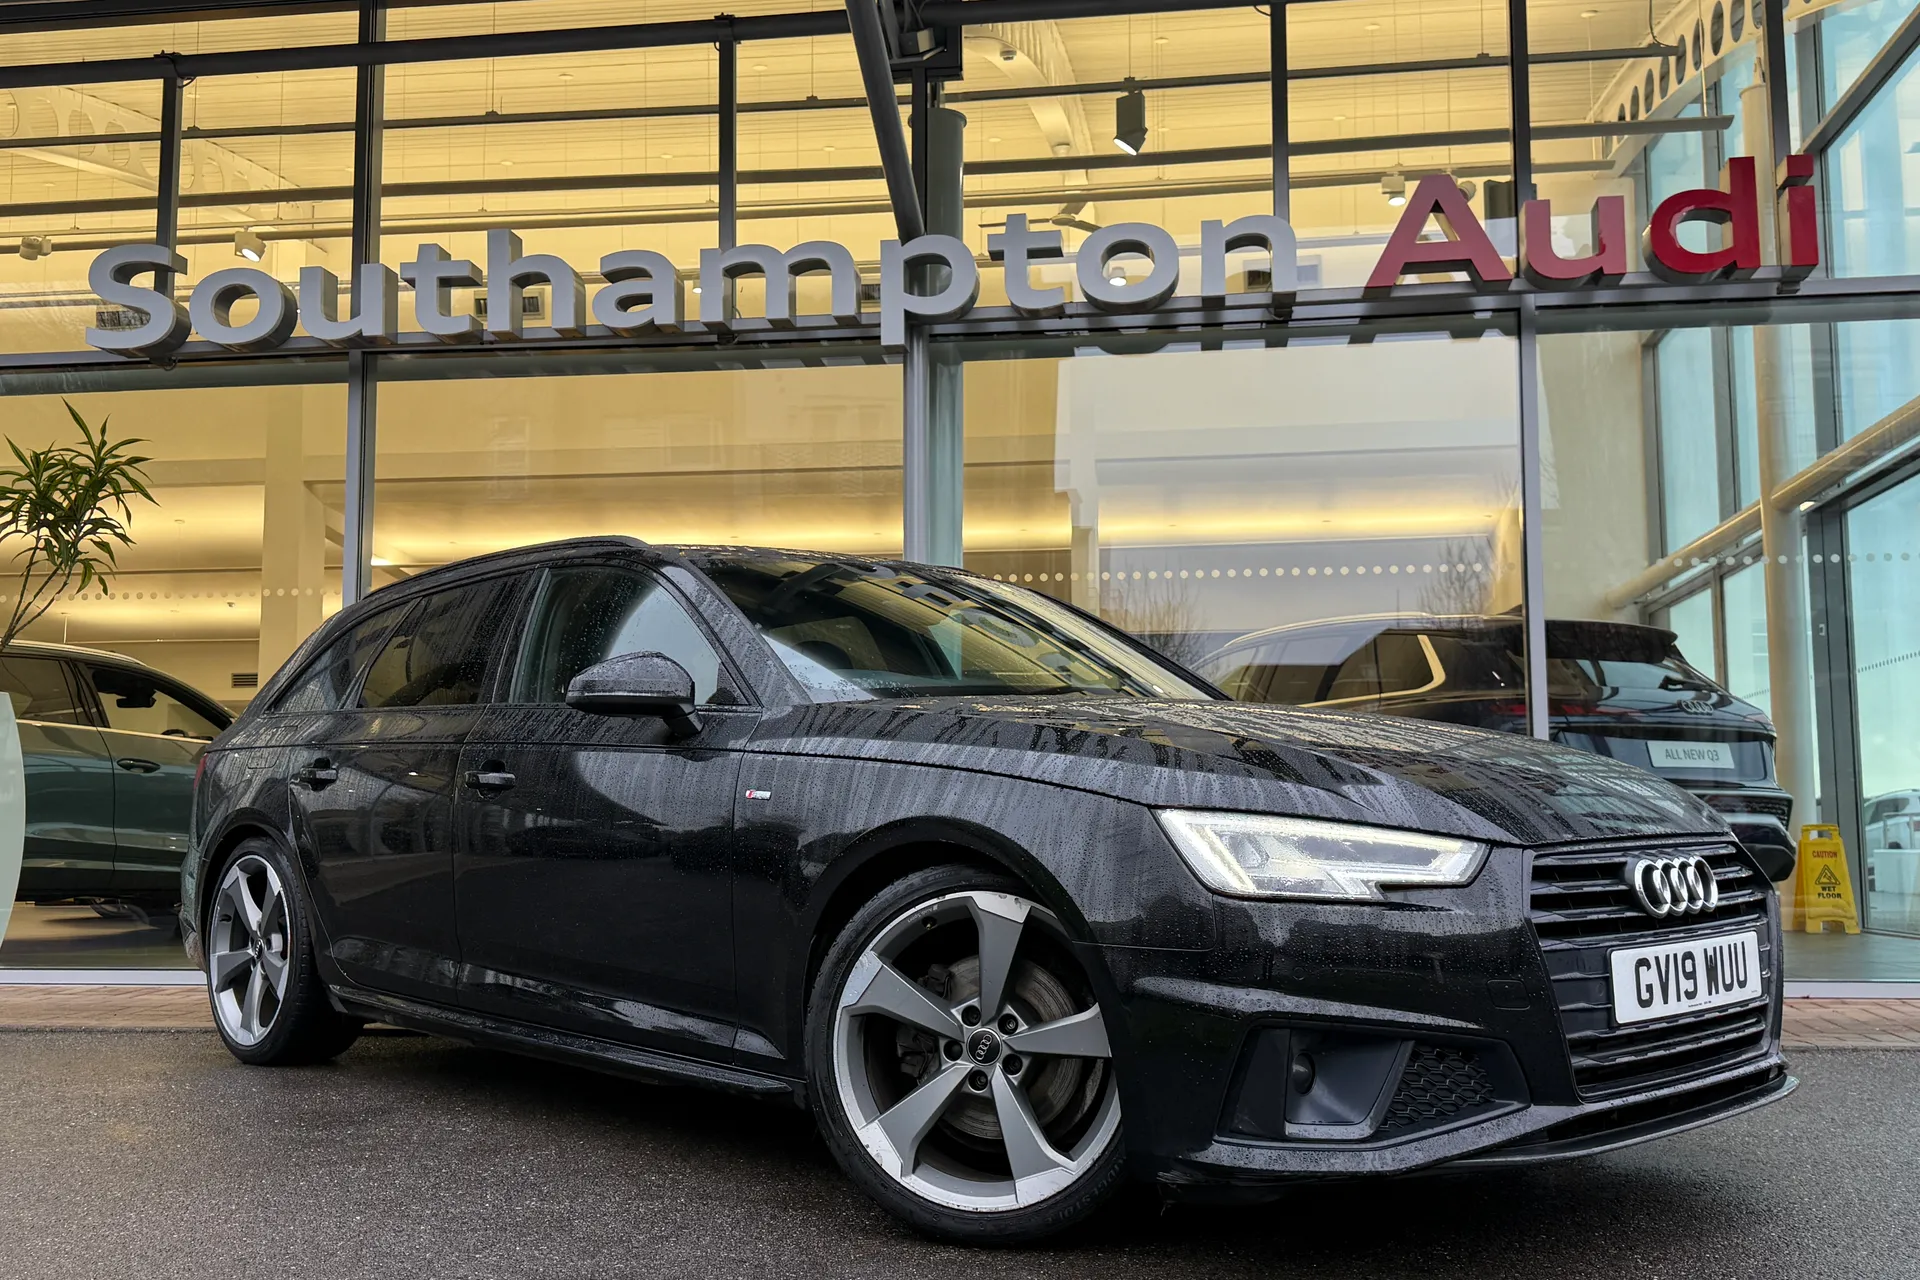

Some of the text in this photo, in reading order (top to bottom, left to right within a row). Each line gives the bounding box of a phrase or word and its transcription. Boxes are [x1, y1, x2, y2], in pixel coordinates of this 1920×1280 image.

[85, 155, 1819, 354] Southampton Audi
[1665, 748, 1720, 762] ALL NEW Q3
[1812, 850, 1838, 858] CAUTION
[1634, 941, 1748, 1009] GV19 WUU
